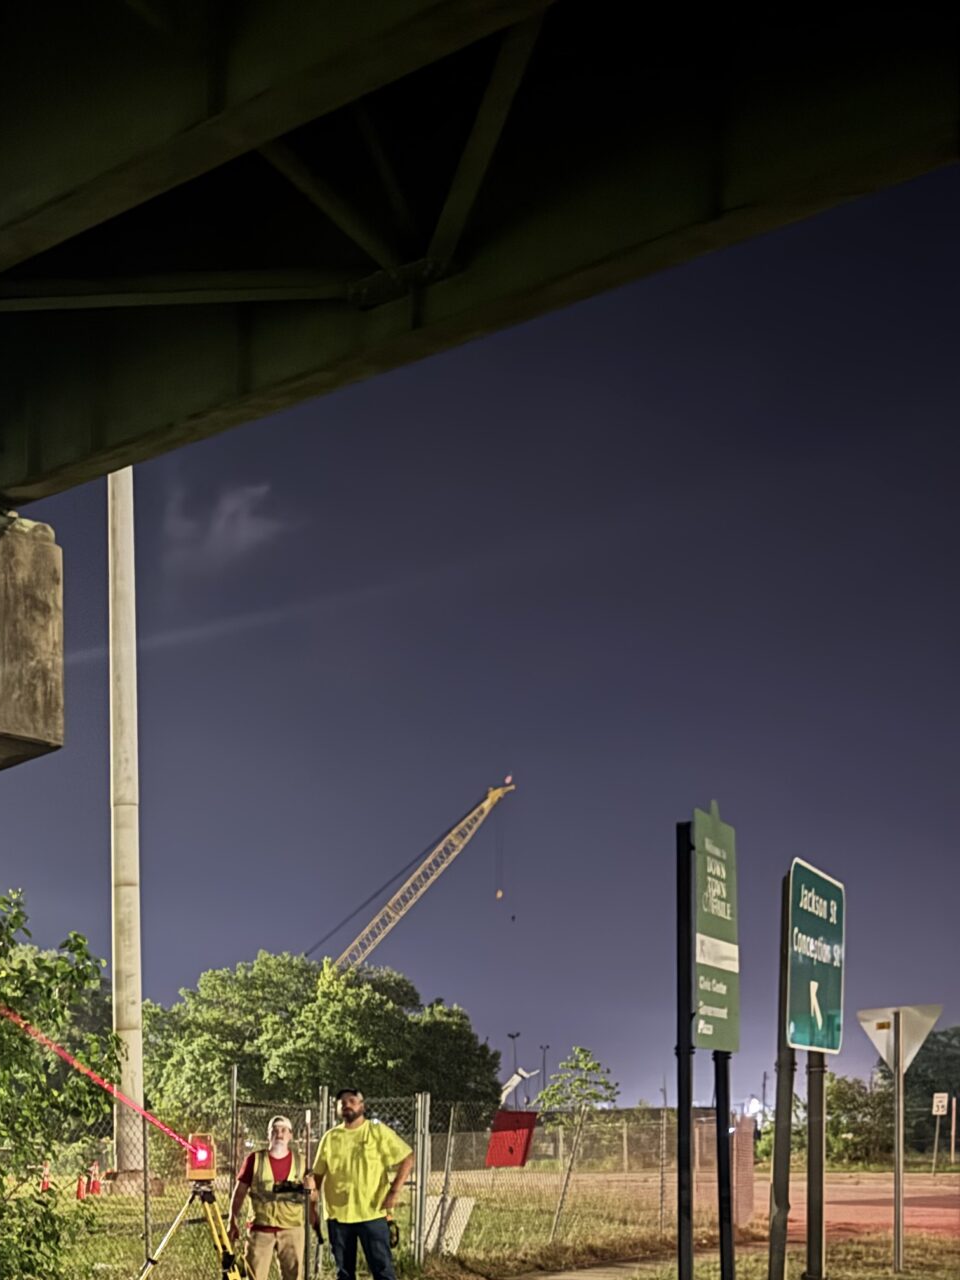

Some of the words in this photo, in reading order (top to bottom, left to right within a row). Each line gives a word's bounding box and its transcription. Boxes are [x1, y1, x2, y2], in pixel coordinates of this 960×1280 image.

[799, 884, 827, 920] Jackson
[829, 899, 837, 924] St
[793, 926, 831, 966] Conception
[833, 944, 841, 968] St
